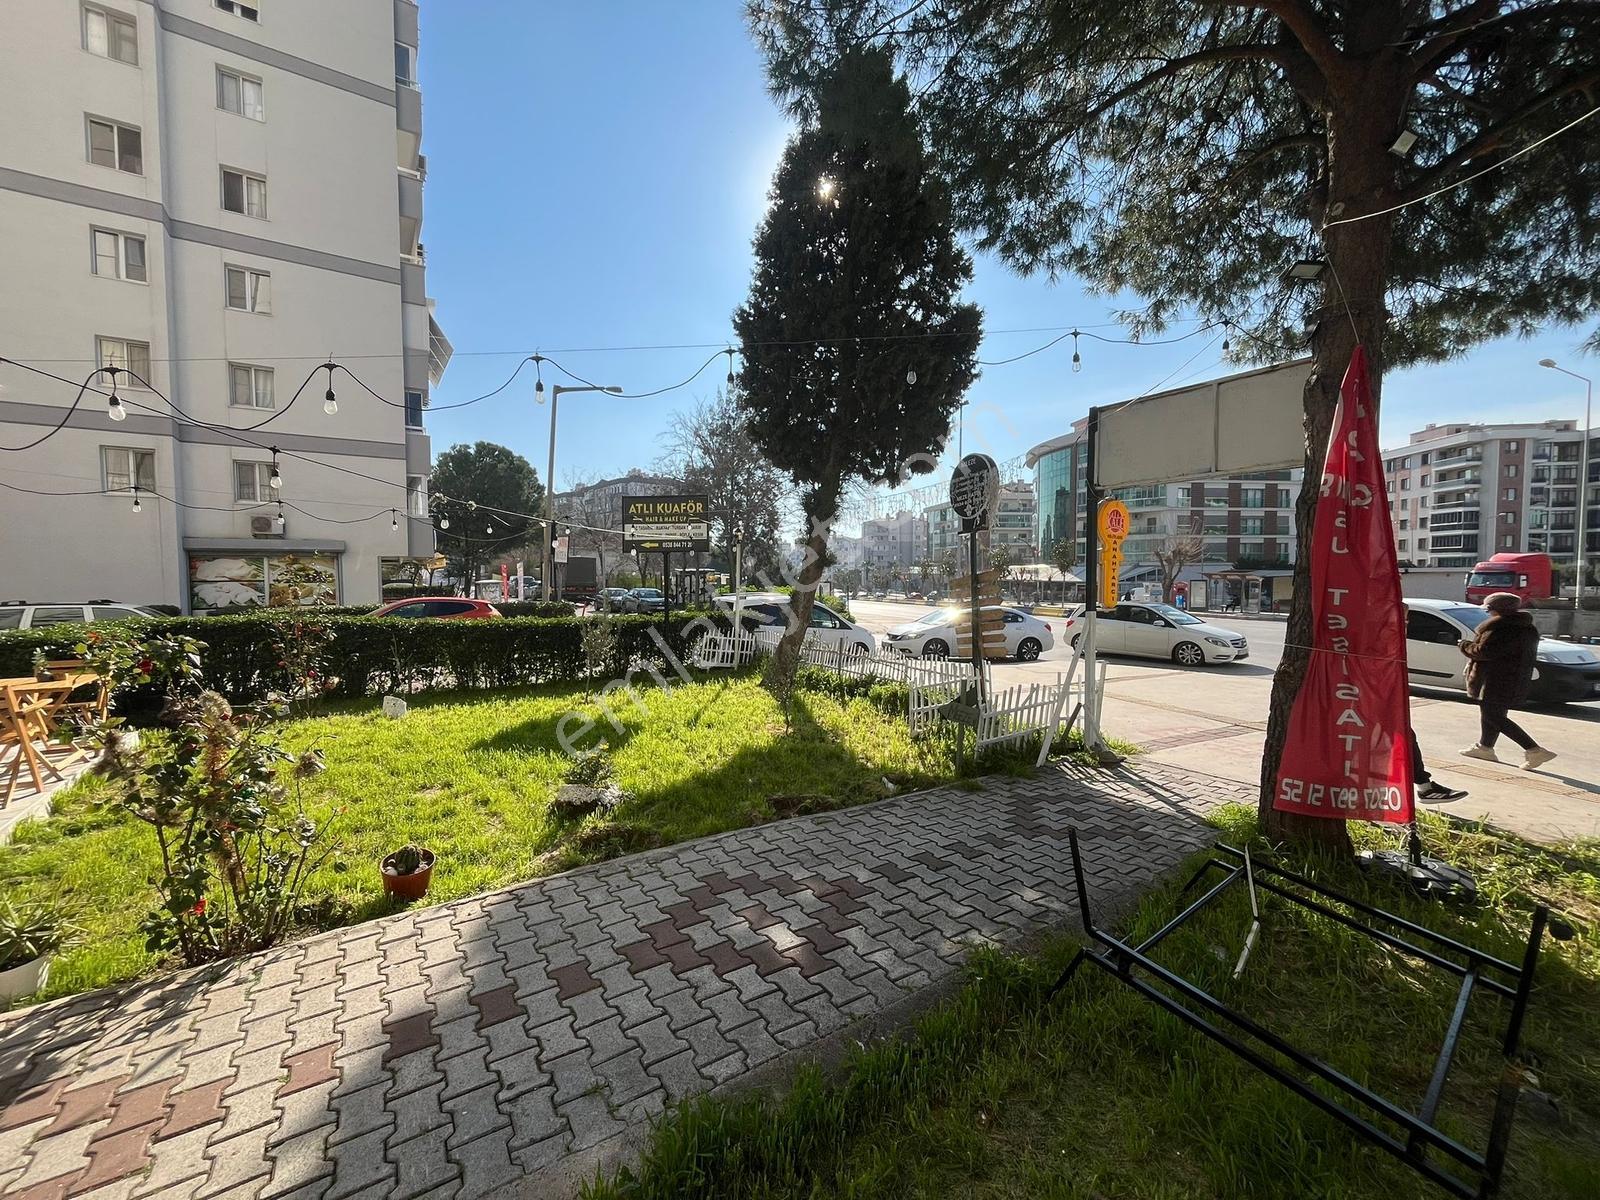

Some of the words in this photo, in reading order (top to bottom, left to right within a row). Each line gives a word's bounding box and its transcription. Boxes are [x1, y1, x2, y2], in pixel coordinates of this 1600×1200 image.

[629, 504, 653, 514] ATLI
[657, 500, 703, 514] KUAFÖR
[1110, 539, 1118, 602] ANAHTARCI
